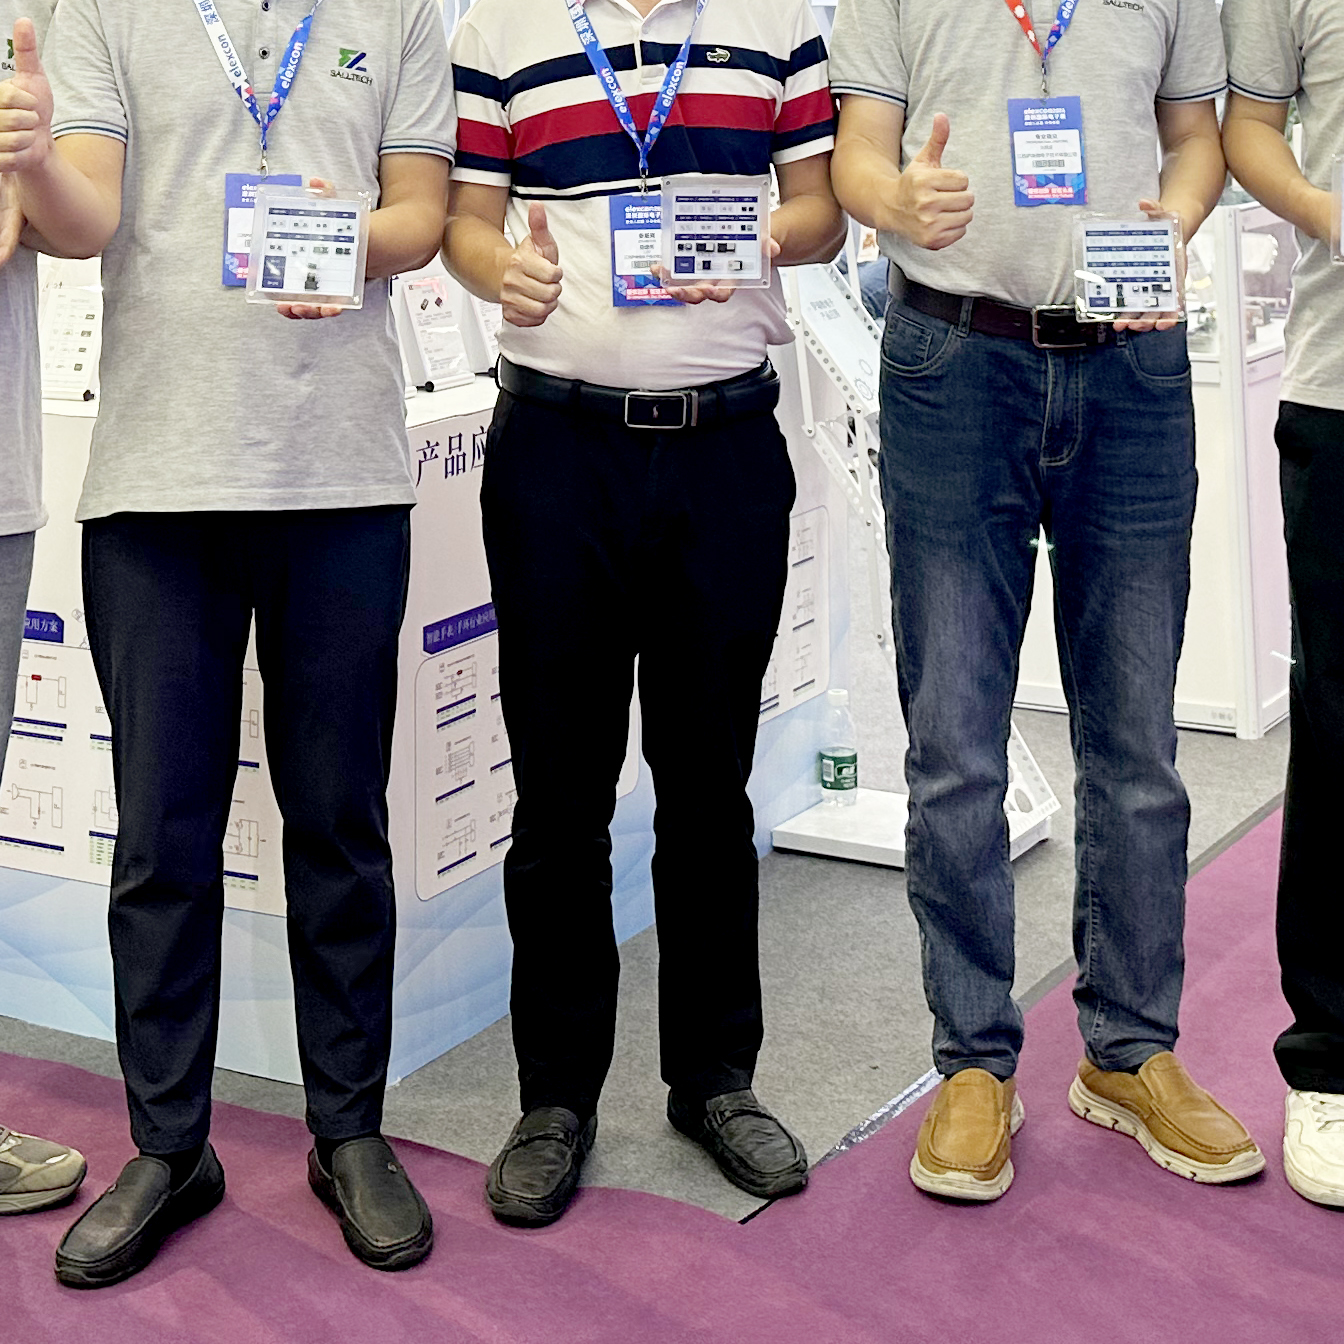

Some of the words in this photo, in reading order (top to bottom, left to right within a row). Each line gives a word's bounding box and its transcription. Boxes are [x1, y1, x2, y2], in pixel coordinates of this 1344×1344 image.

[217, 34, 242, 78] elexcon
[280, 42, 304, 89] elexcon
[330, 70, 373, 86] SALLTECH
[601, 67, 627, 114] elexcon
[662, 61, 686, 107] elexcon
